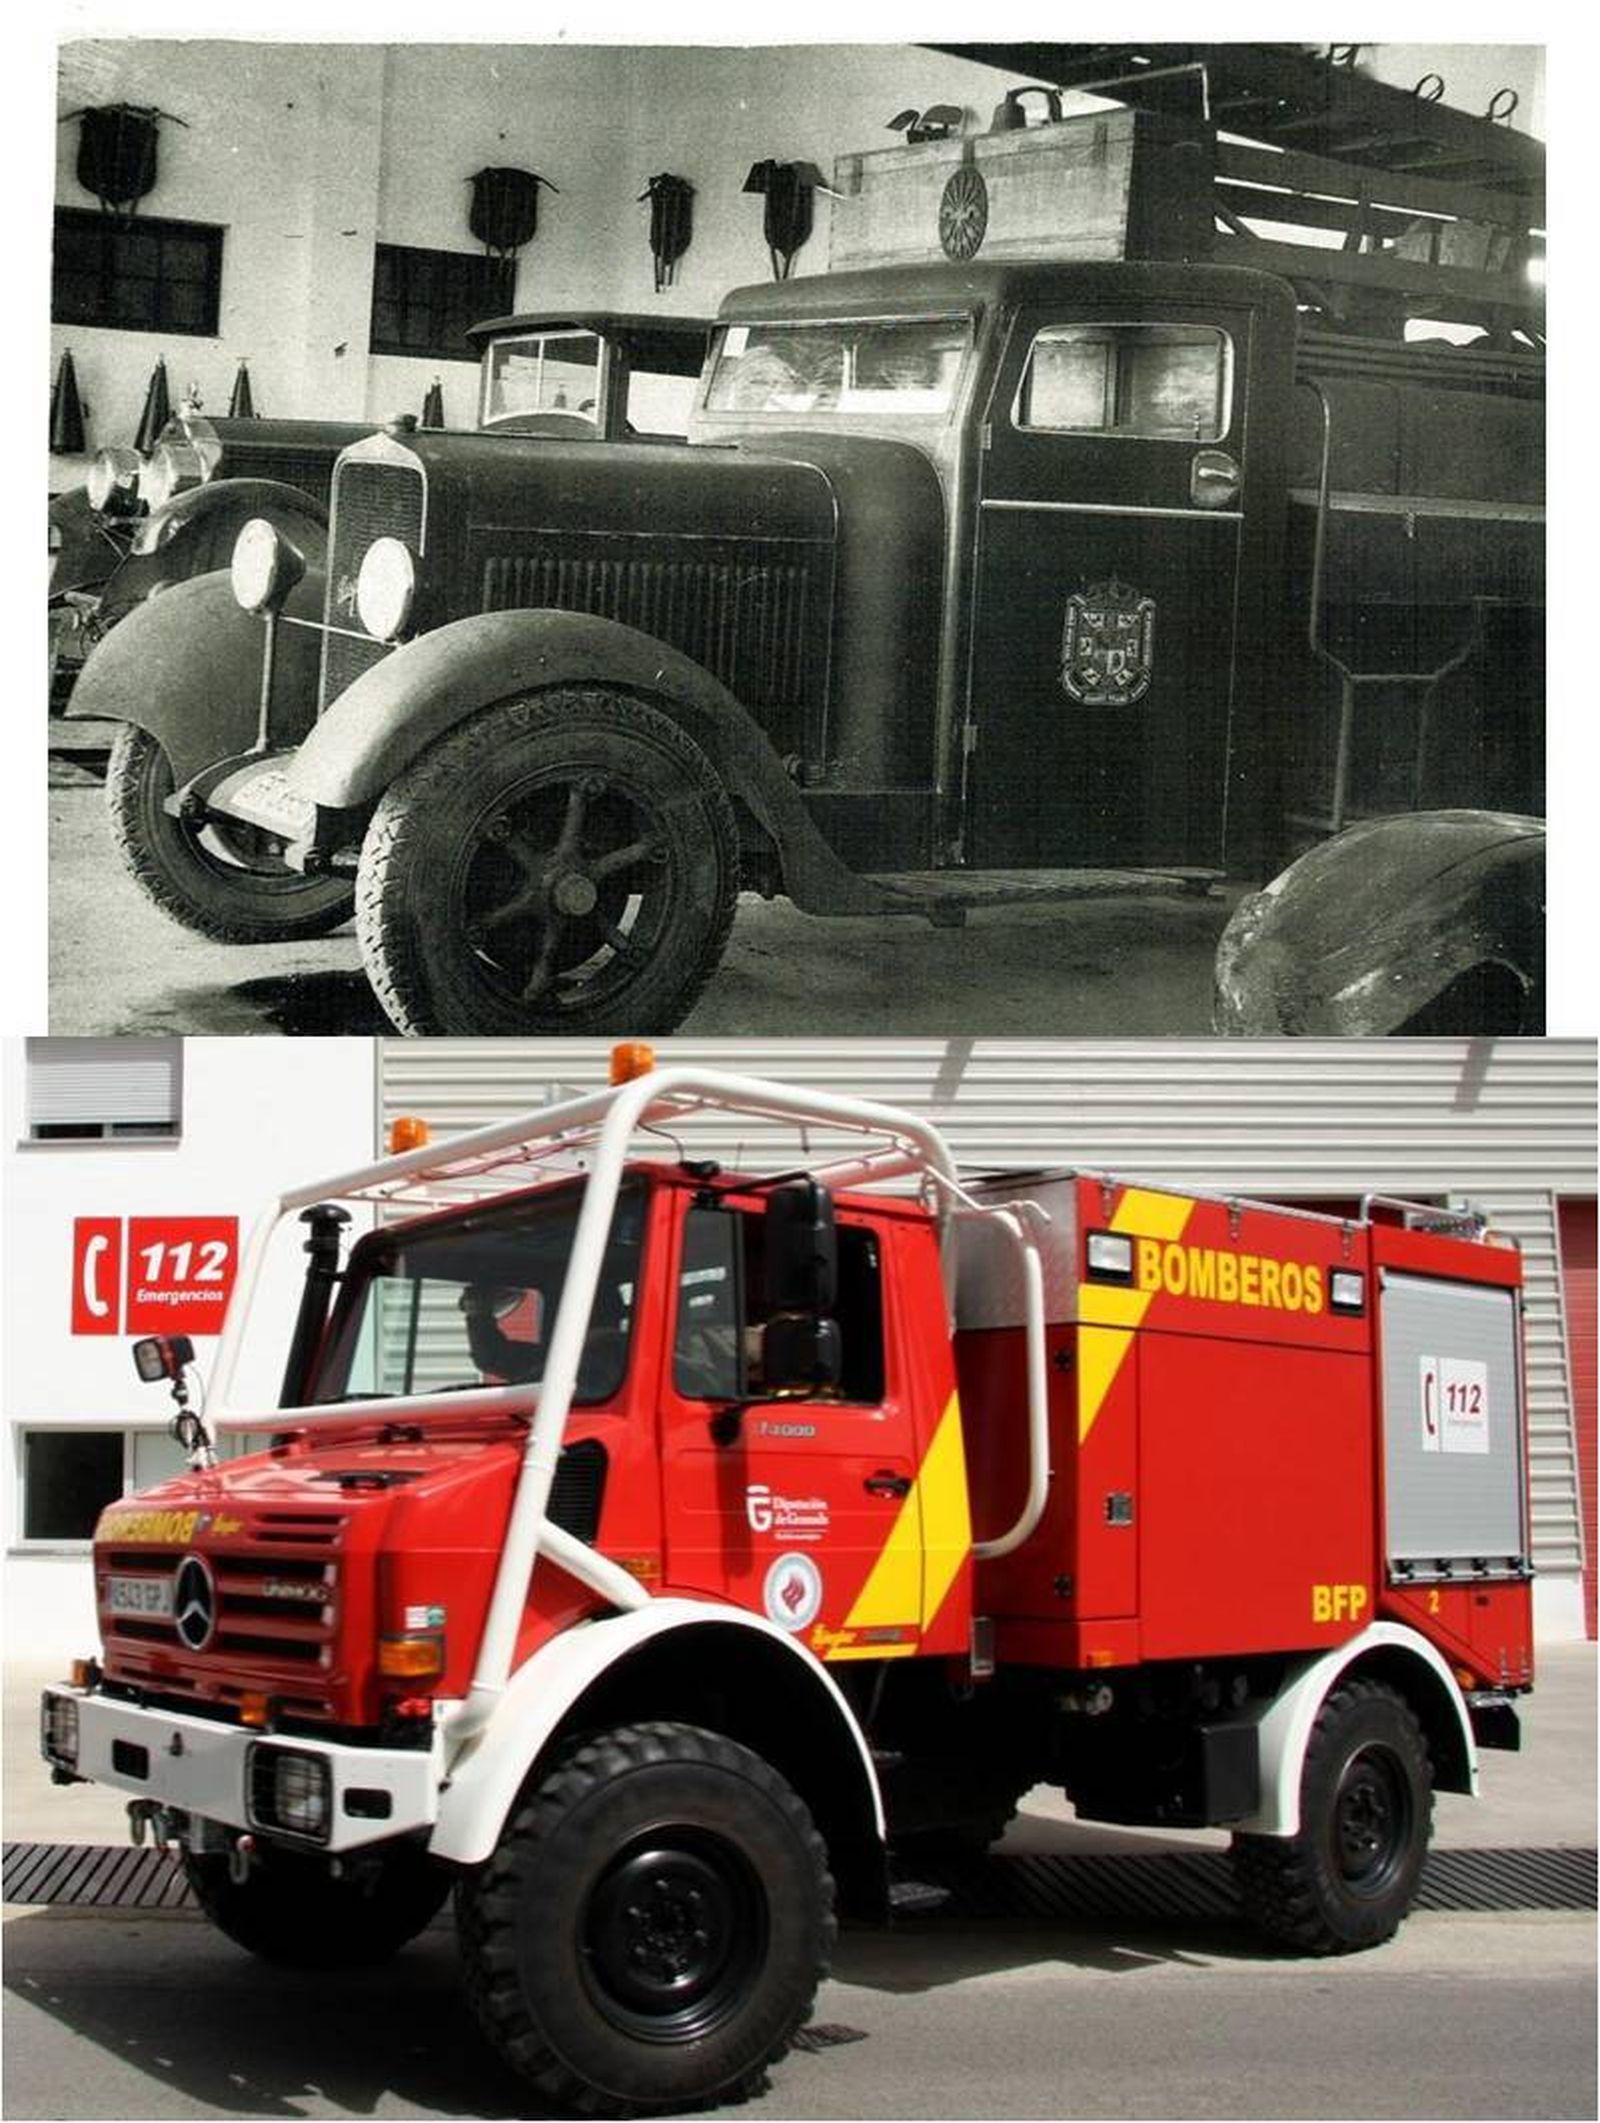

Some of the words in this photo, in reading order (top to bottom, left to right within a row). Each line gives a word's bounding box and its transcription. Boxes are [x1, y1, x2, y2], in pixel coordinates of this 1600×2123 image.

[139, 1240, 229, 1282] 112
[1137, 1238, 1323, 1315] BOMBEROS
[137, 1288, 224, 1305] Emergencias
[1447, 1383, 1482, 1414] 112
[1312, 1585, 1367, 1622] BFP
[1428, 1589, 1440, 1614] 2
